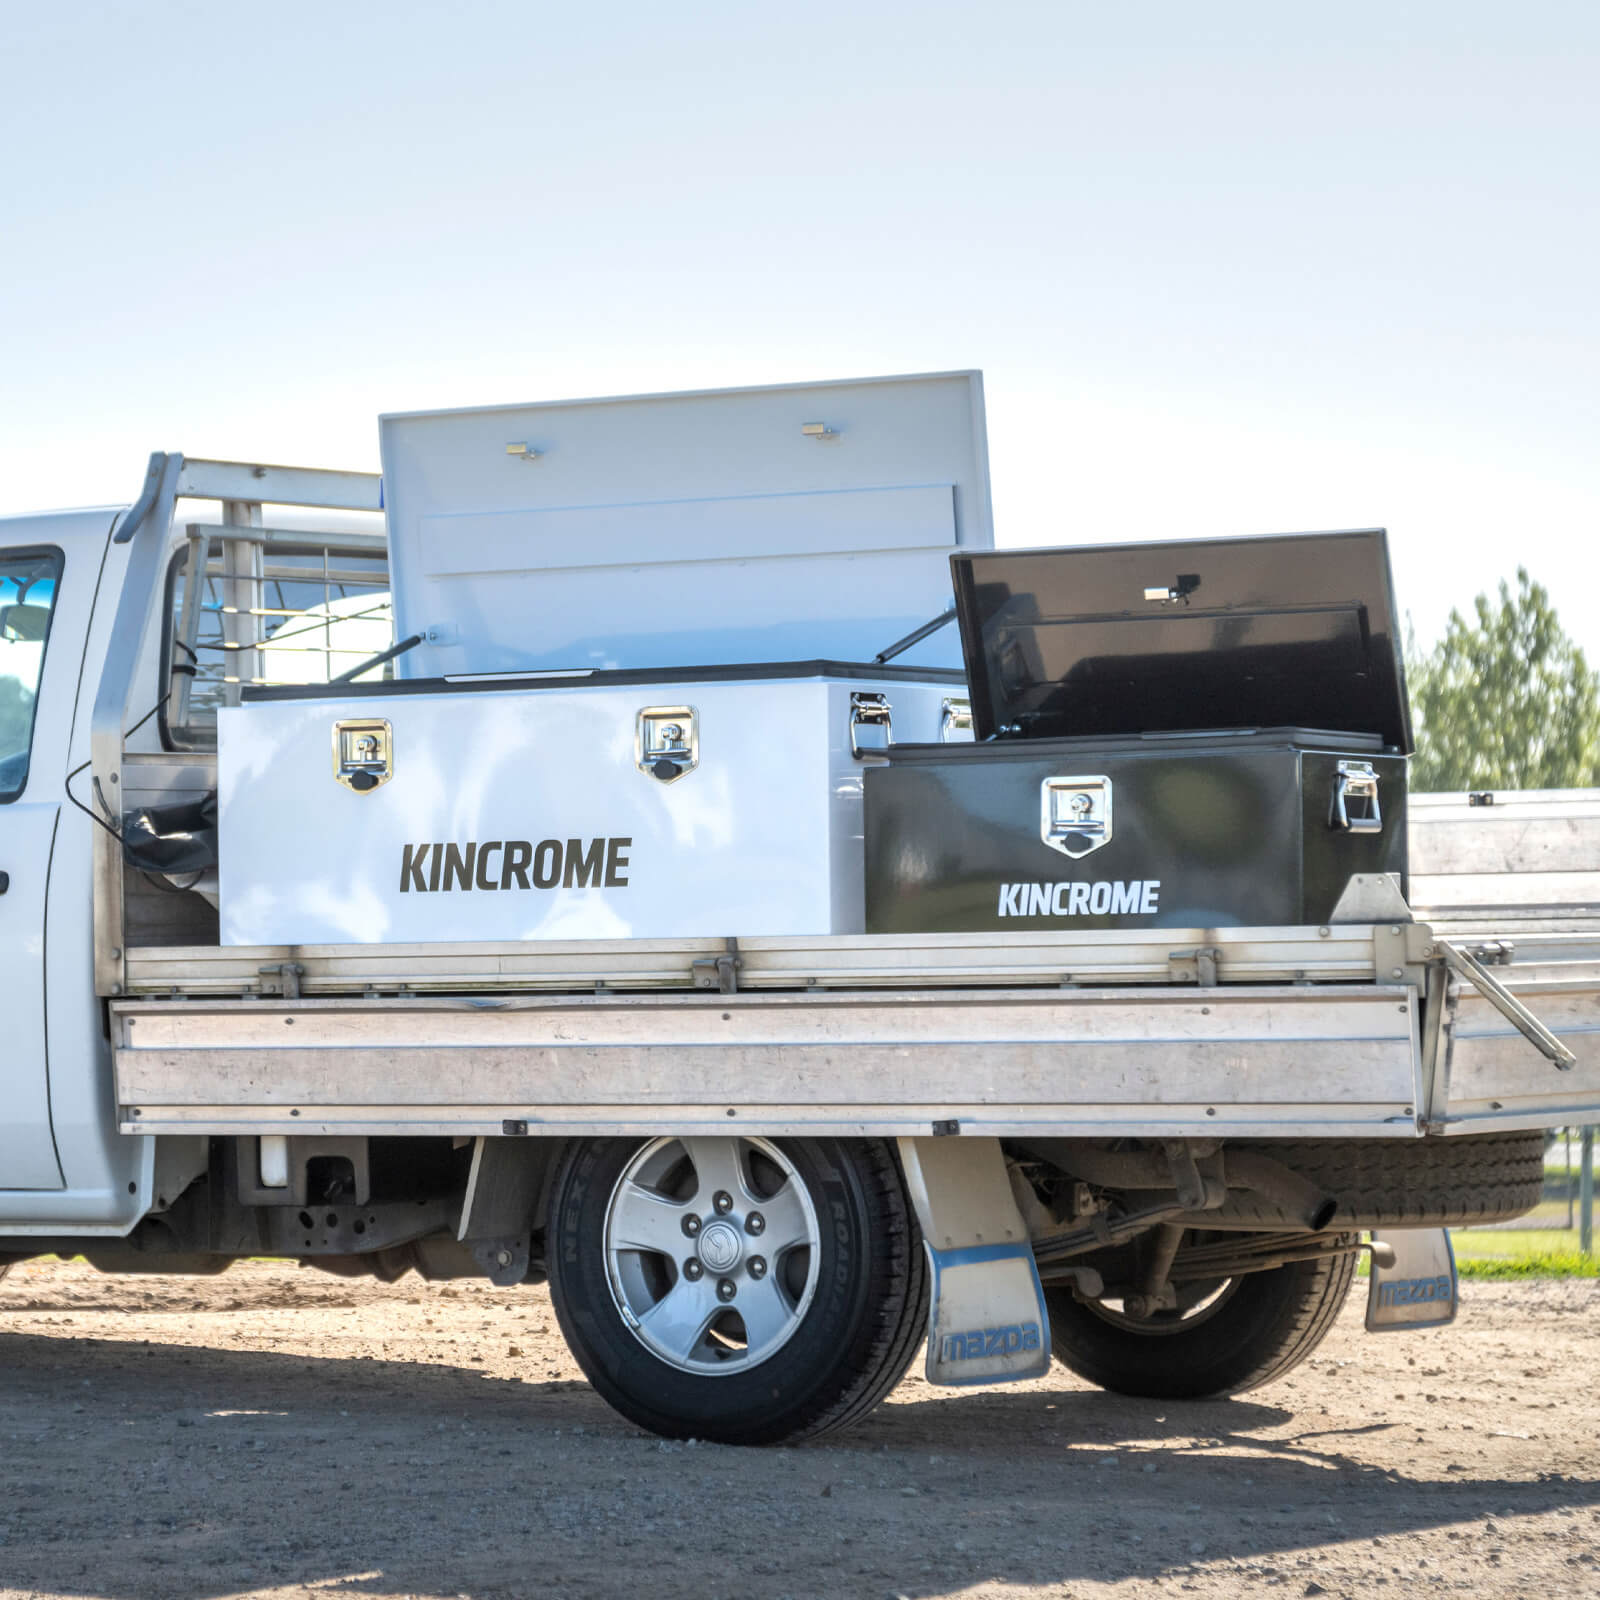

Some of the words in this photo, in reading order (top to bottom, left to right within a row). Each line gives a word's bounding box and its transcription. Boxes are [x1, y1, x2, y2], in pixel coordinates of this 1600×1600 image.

[400, 838, 632, 892] KINCROME
[998, 880, 1161, 917] KINCROME
[941, 1322, 1040, 1361] mazda
